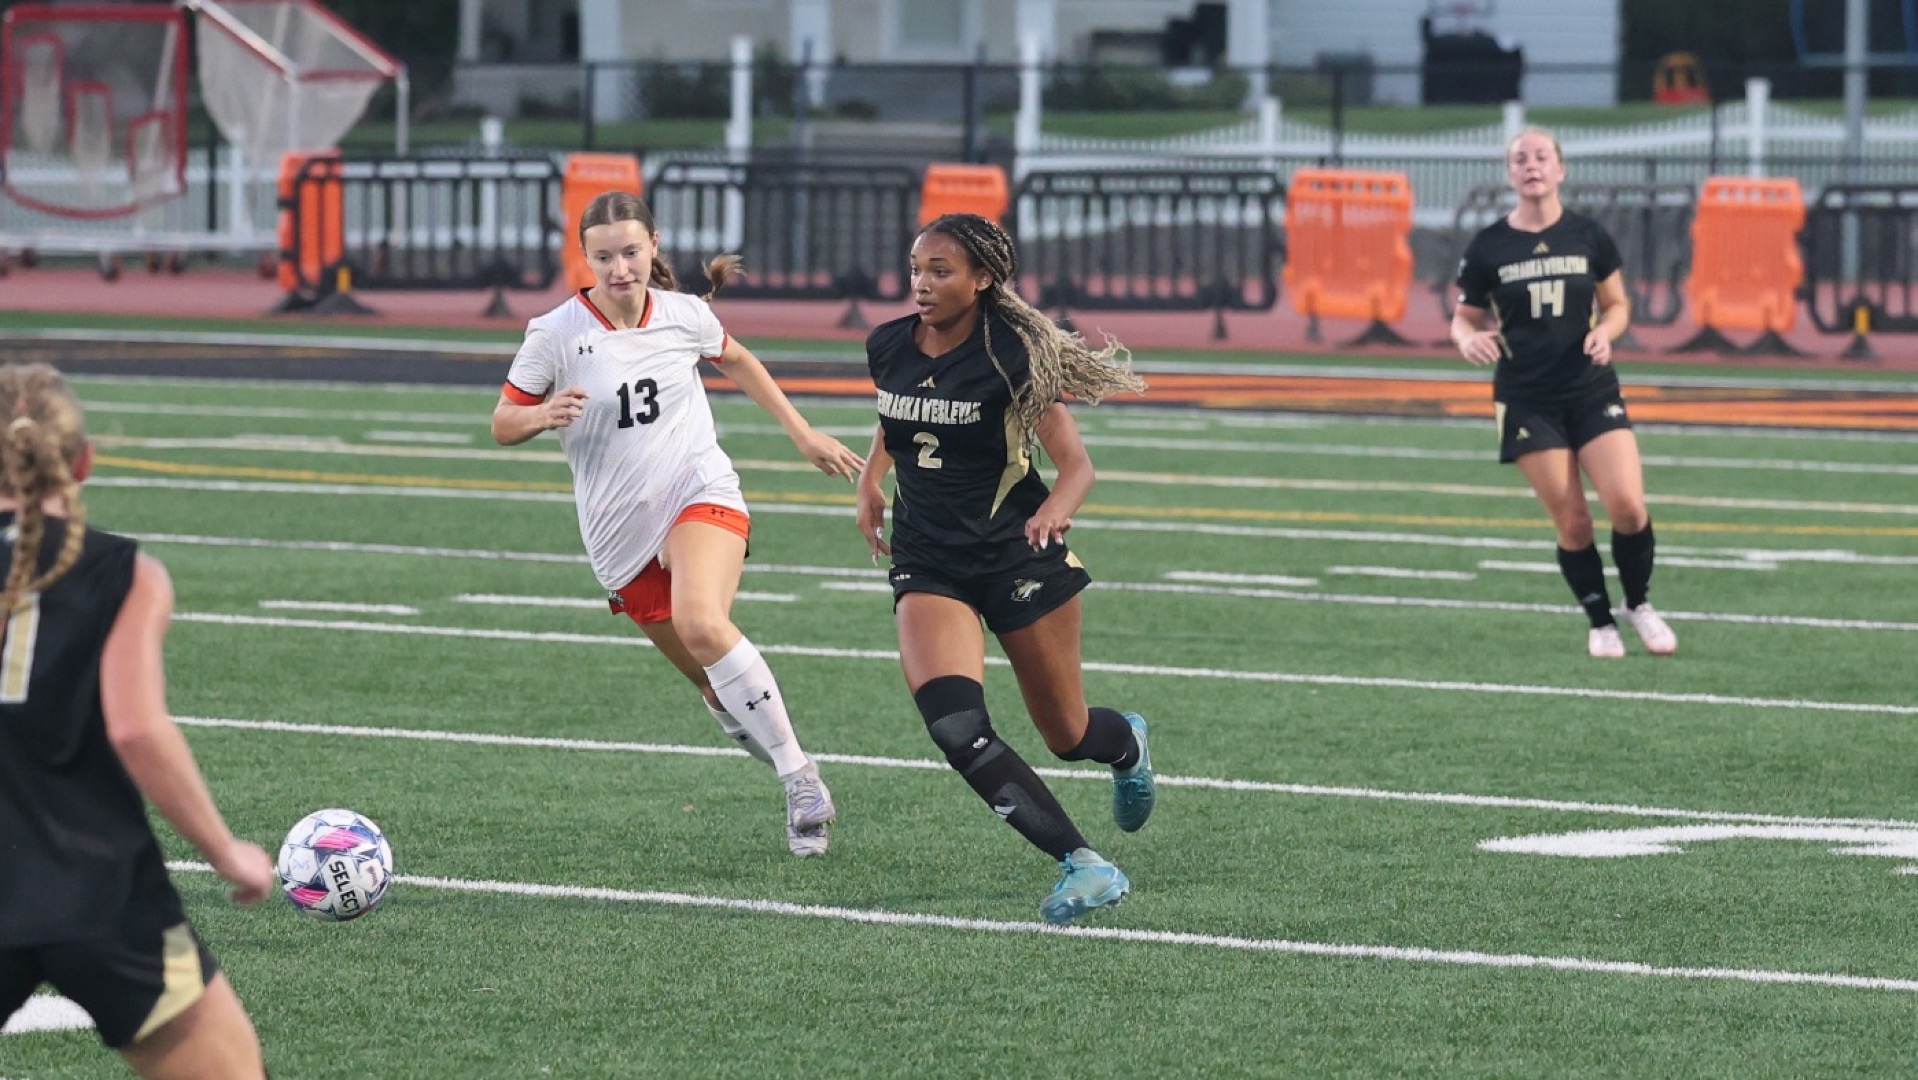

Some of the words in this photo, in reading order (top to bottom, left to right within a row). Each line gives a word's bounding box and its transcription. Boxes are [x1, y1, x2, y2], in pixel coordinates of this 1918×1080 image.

[1527, 279, 1565, 319] 14
[616, 377, 660, 429] 13
[877, 388, 920, 422] EBRASKA
[913, 431, 942, 469] 2
[328, 860, 361, 913] SELECT
